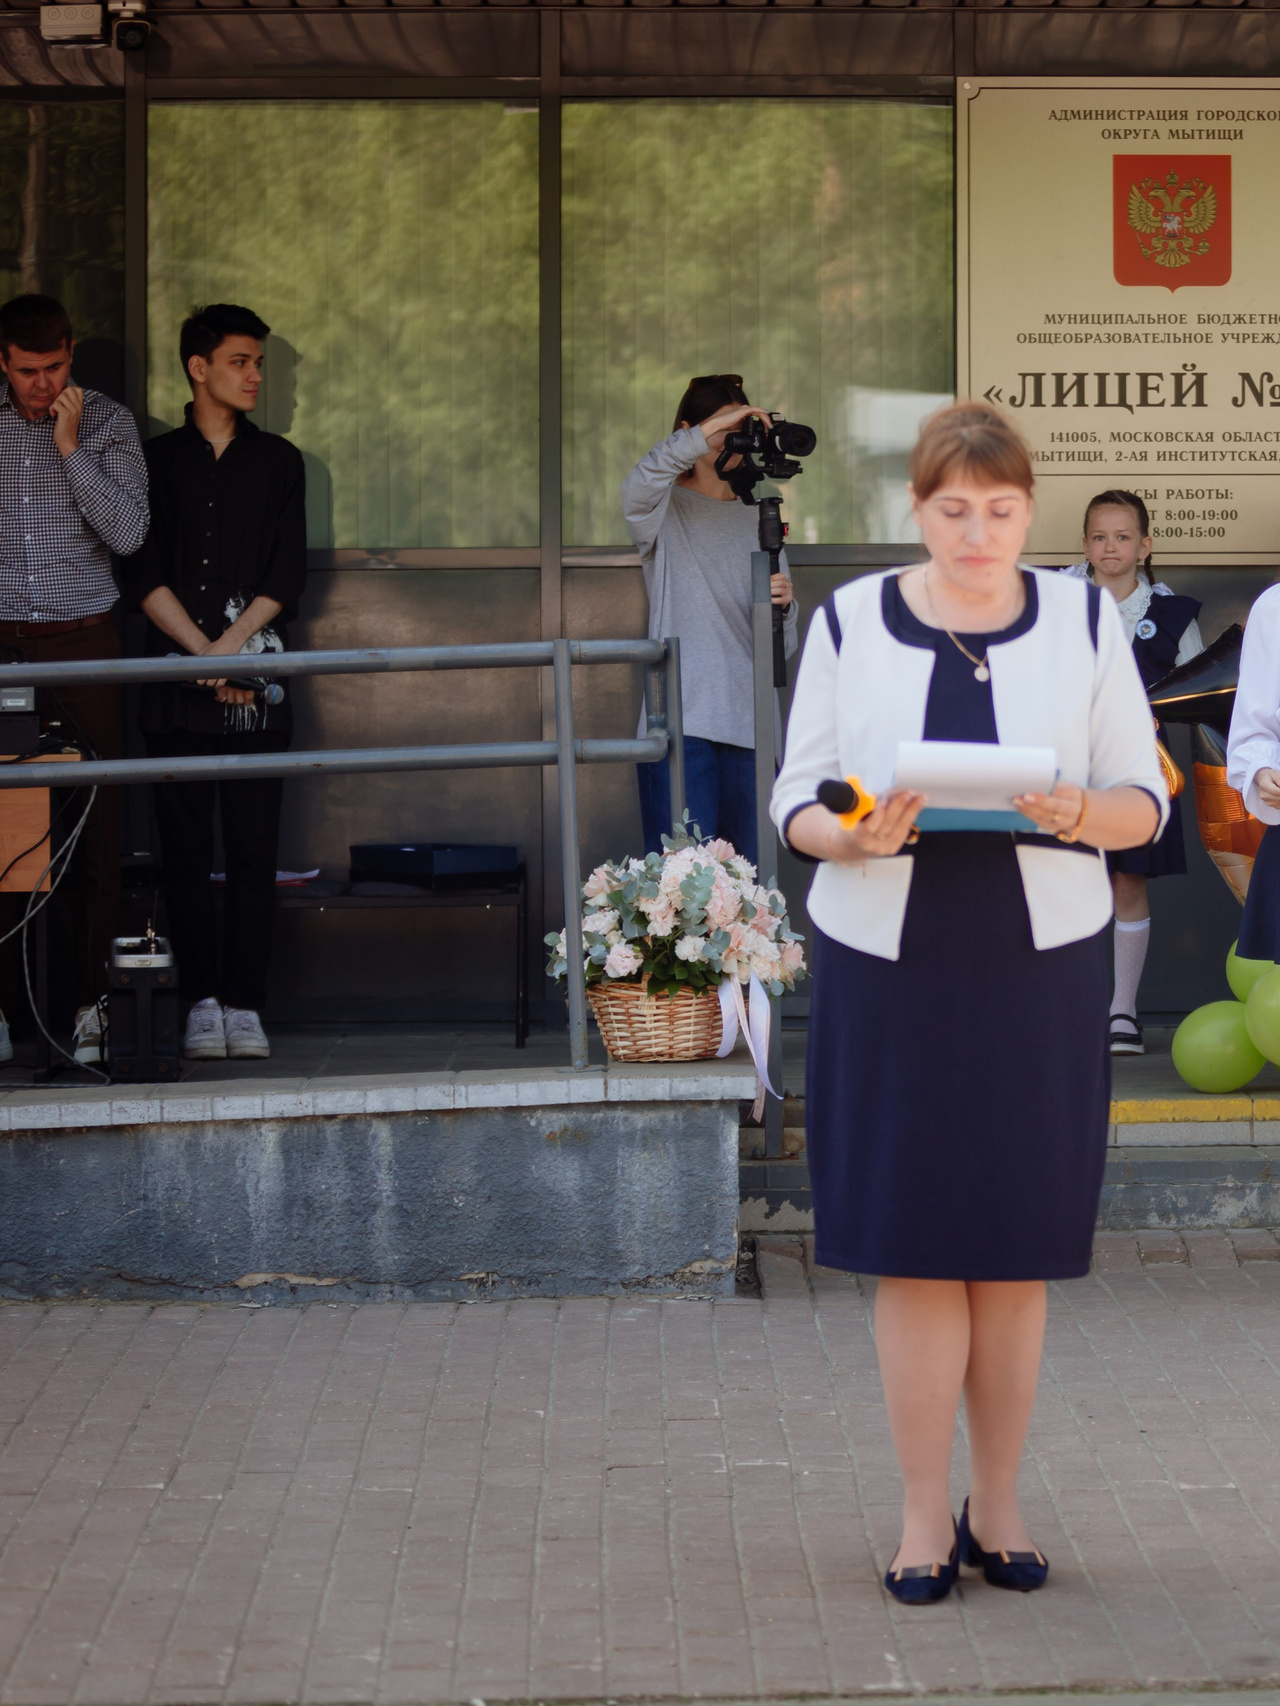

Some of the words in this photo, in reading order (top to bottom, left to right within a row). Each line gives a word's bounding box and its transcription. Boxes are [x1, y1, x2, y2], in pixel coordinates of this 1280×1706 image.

[1048, 109, 1189, 123] АДМИНИСТРАЦИЯ
[1101, 128, 1161, 140] ОКРУГА
[1167, 128, 1244, 142] МЫТИЩИ
[1043, 313, 1188, 327] МУНИЦИПАЛЬНОЕ
[1016, 332, 1214, 345] ОБЩЕОБРАЗОВАТЕЛЬНОЕ
[982, 363, 1209, 415] «ЛИЦЕЙ
[1050, 431, 1102, 444] 141005,
[1109, 431, 1215, 443] МОСКОВСКАЯ
[1115, 450, 1149, 462] 2-АЯ
[1166, 488, 1234, 500] РАБОТЫ:
[1165, 509, 1238, 521] 8:00-19:00
[1152, 526, 1226, 538] 8:00-15:00
